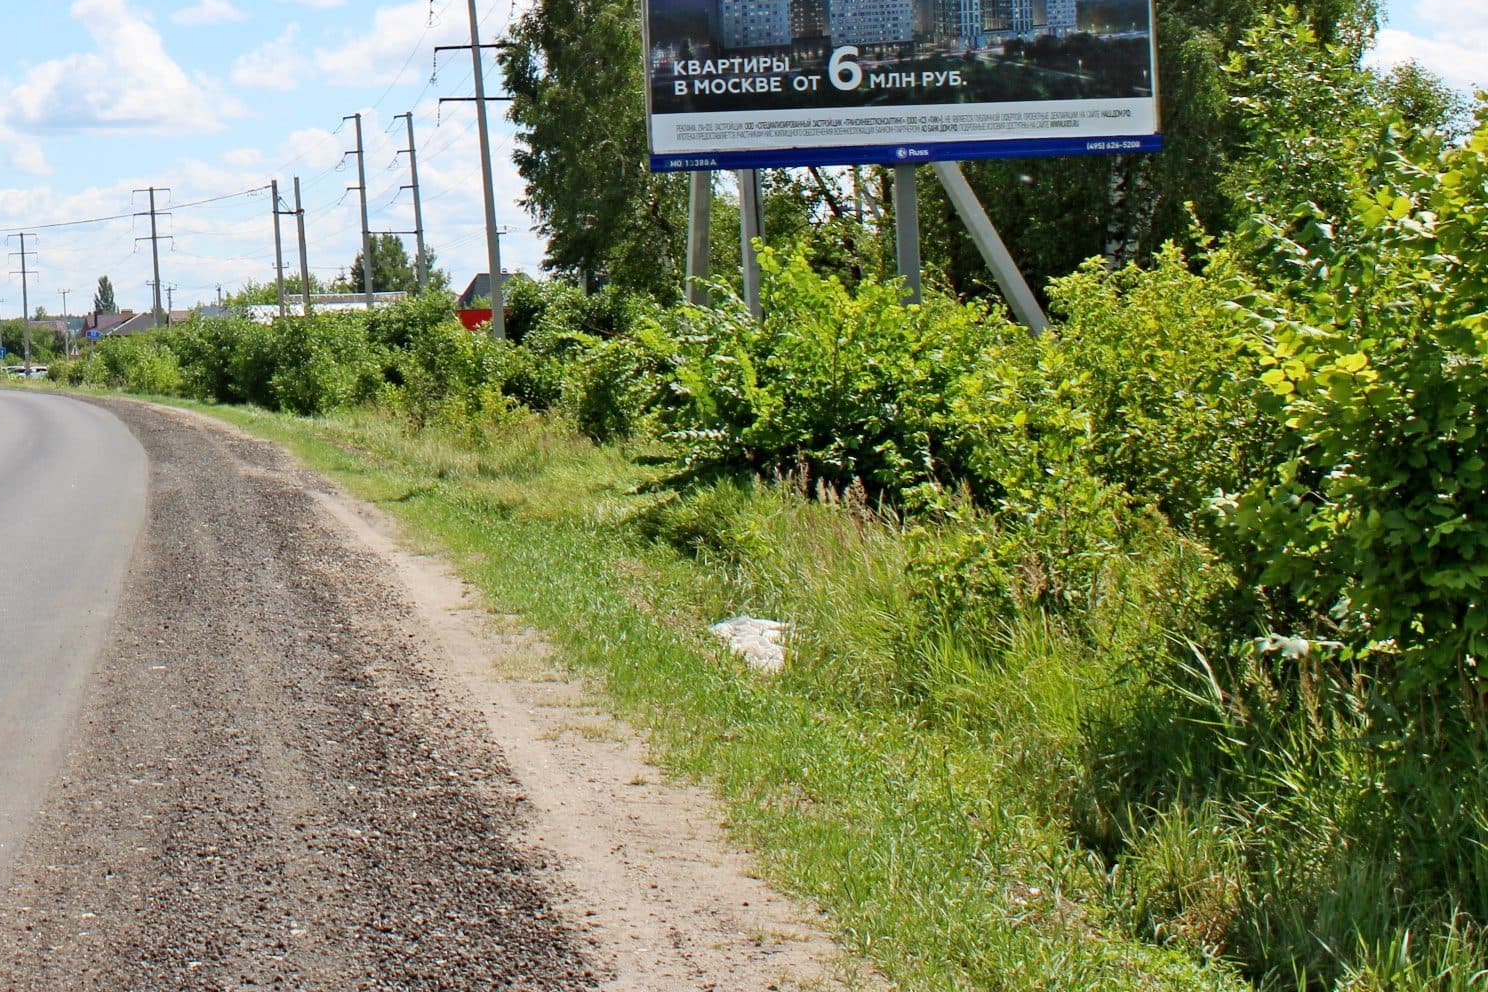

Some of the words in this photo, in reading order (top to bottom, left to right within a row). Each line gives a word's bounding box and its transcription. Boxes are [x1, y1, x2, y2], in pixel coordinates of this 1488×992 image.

[673, 56, 791, 76] КВАРТИРЫ
[674, 81, 688, 96] В
[694, 76, 783, 95] МОСКВЕ
[792, 75, 822, 92] ОТ
[828, 45, 863, 91] 6
[870, 72, 915, 89] МЛН
[922, 70, 968, 87] РУБ.
